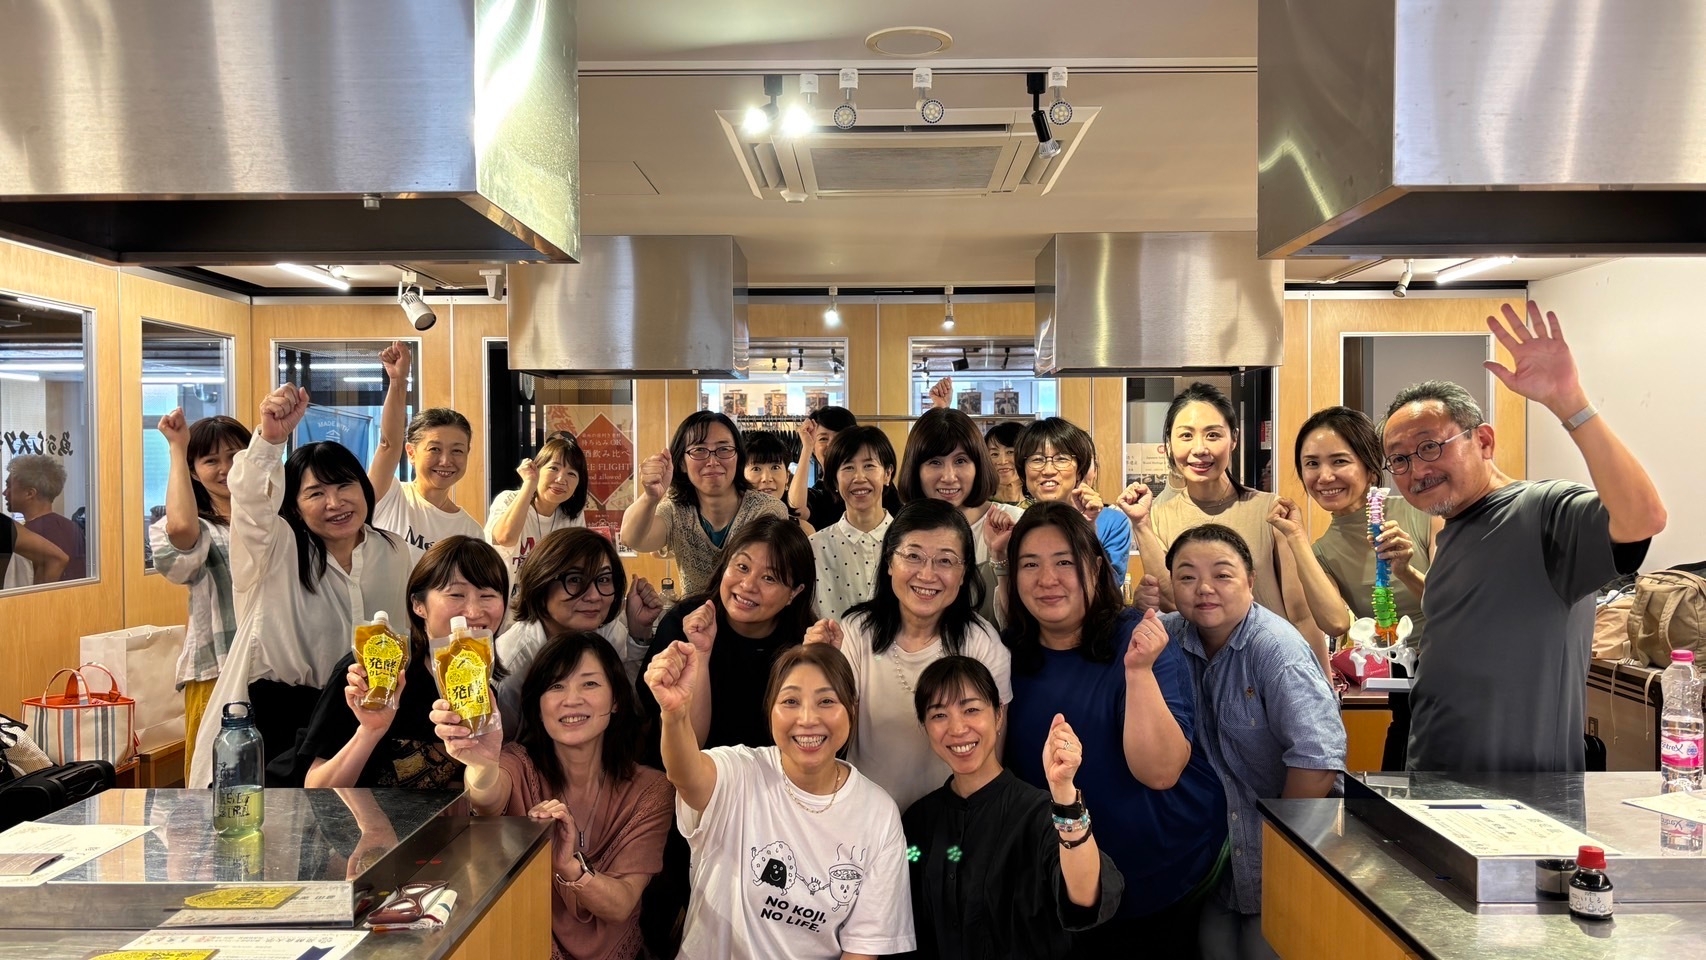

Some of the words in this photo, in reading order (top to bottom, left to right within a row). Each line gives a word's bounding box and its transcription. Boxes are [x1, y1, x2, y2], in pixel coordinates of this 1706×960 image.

[598, 463, 631, 471] FLIGHT
[761, 907, 784, 923] NO
[786, 914, 821, 933] LIFE.
[765, 895, 790, 911] NO
[792, 904, 827, 924] KOJI,
